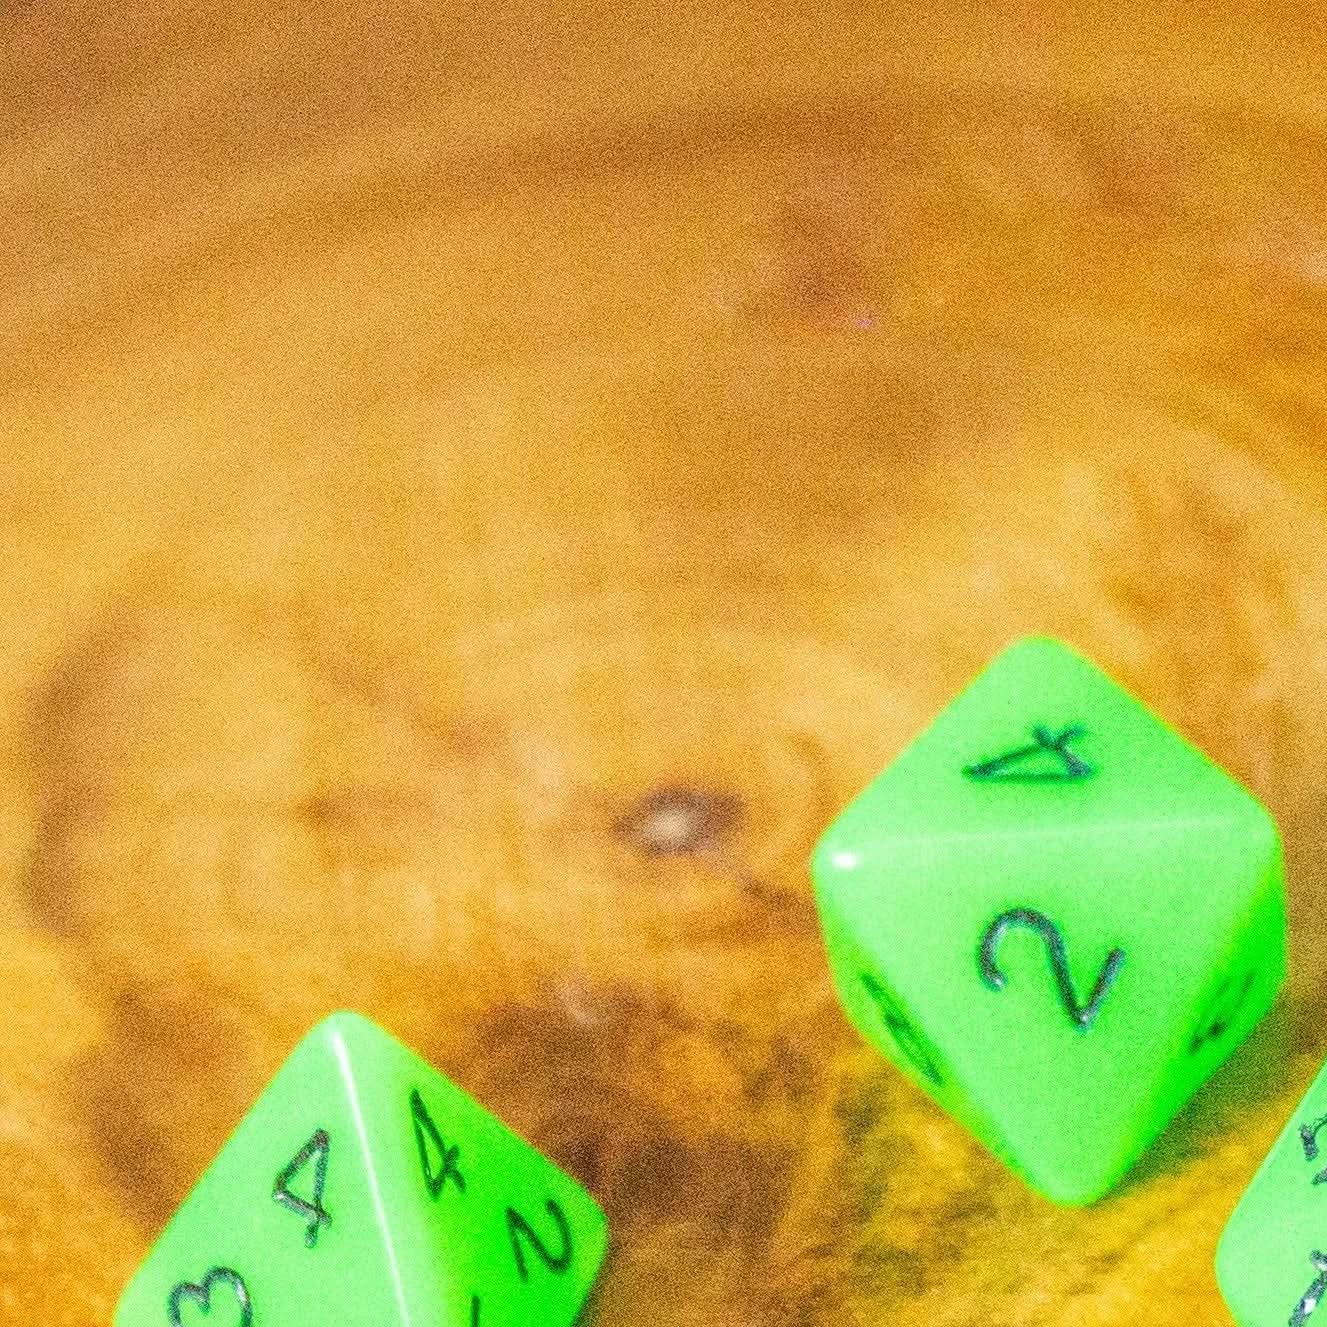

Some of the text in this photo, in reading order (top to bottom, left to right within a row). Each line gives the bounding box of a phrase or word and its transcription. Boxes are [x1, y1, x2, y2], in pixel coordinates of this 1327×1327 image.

[964, 722, 1095, 784] 4
[979, 907, 1126, 1033] 2
[272, 1130, 332, 1248] 4
[411, 1089, 466, 1200] 4
[507, 1199, 574, 1282] 2
